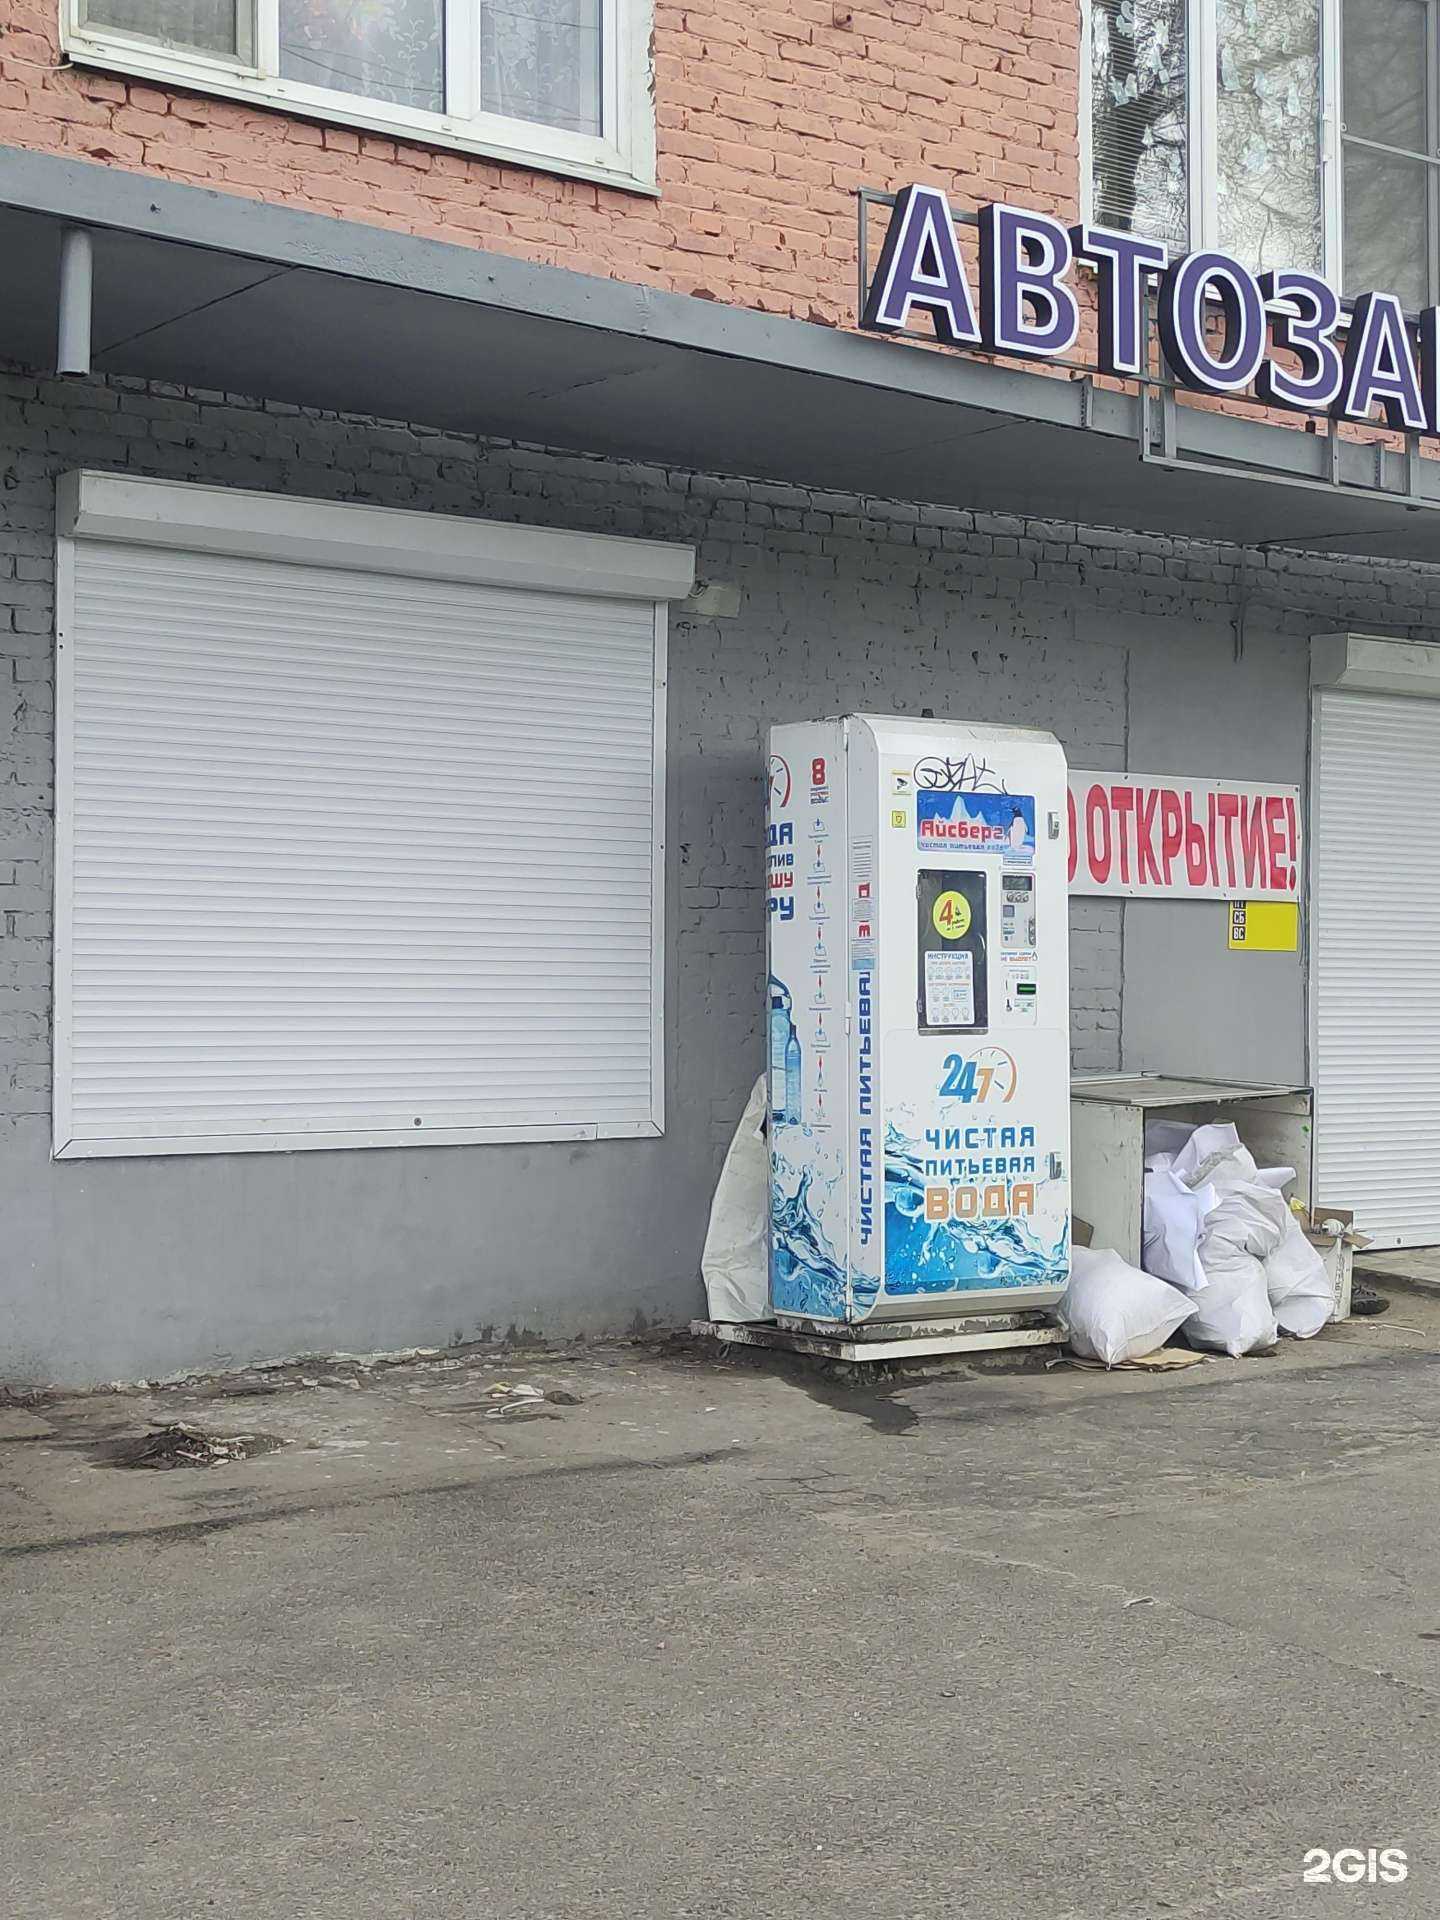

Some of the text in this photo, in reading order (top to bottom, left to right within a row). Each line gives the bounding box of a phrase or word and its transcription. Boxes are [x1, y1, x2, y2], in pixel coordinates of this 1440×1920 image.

[876, 183, 1440, 430] АВТОЗА
[921, 820, 1004, 843] Айсберг
[1086, 783, 1297, 892] ОТКРЫТИЕ!
[939, 899, 953, 926] 4
[1234, 911, 1245, 924] СБ
[925, 1126, 1035, 1150] ЧИСТАЯ
[925, 1155, 1035, 1177] ПИТЬЕВАЯ
[859, 1127, 872, 1245] ЧИСТАЯ
[926, 1183, 1035, 1220] ВОДА
